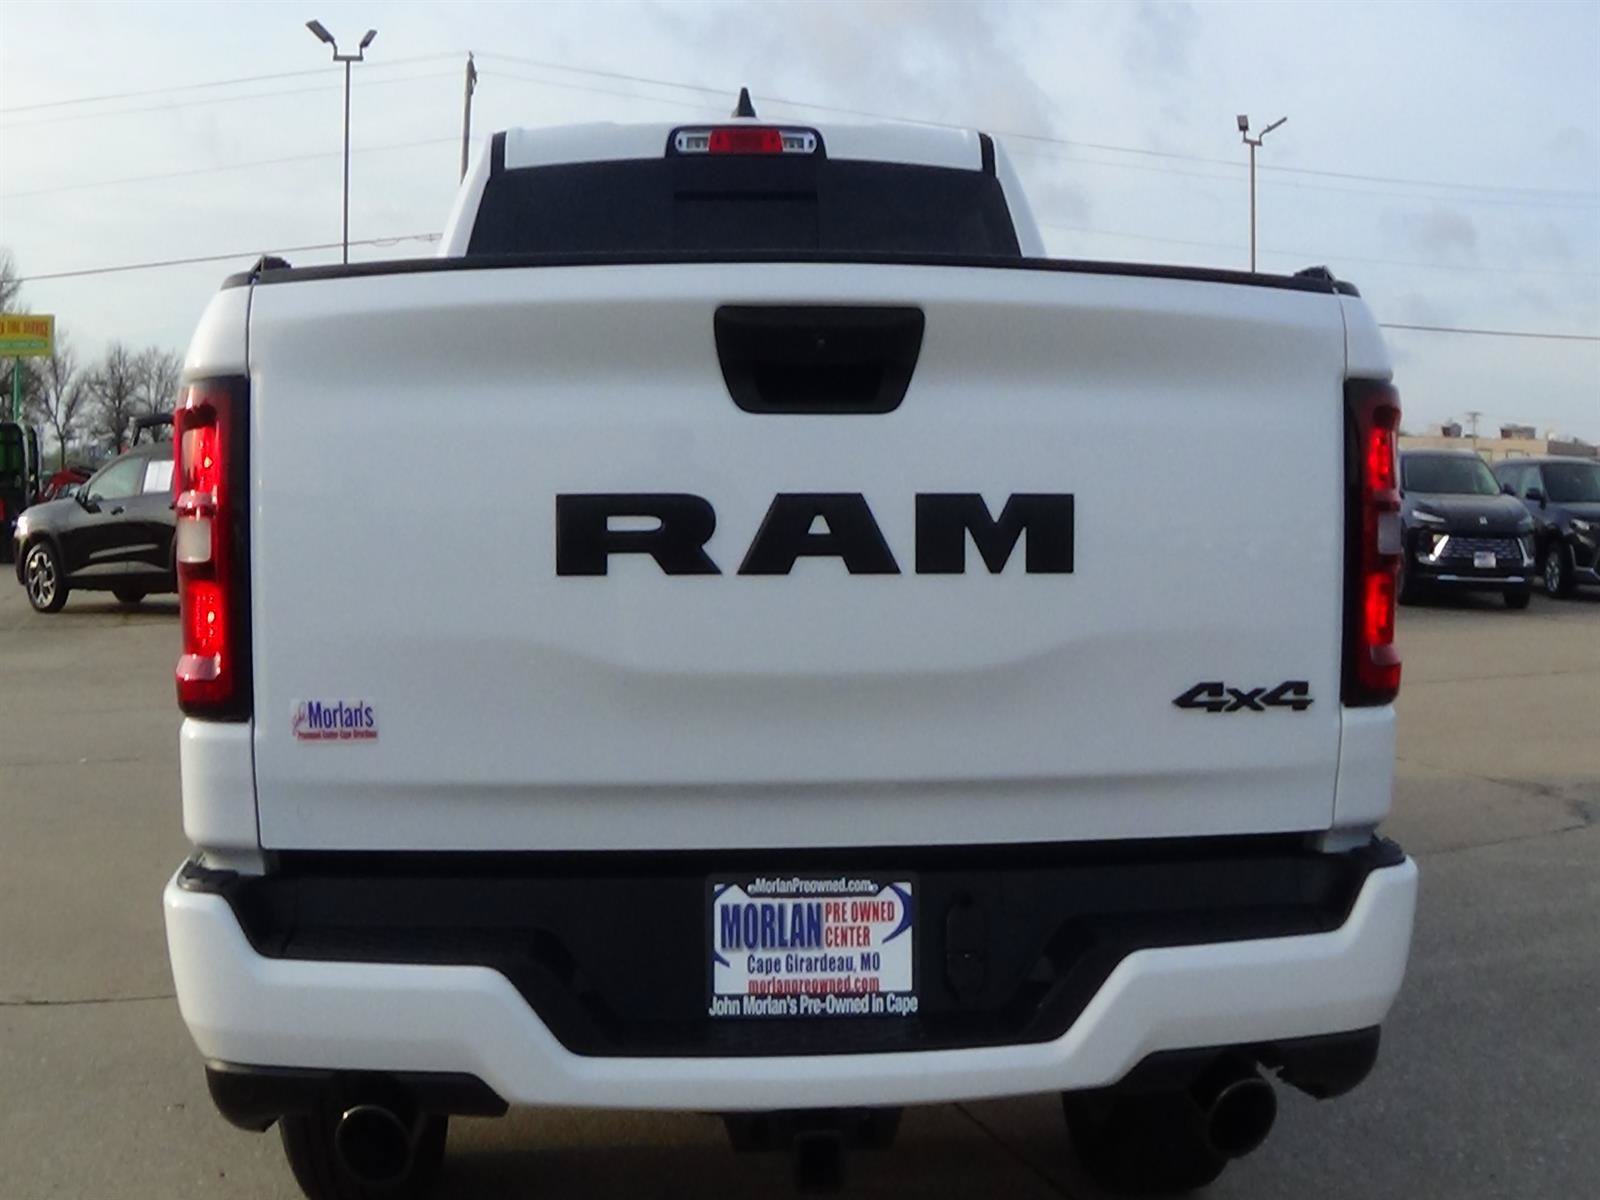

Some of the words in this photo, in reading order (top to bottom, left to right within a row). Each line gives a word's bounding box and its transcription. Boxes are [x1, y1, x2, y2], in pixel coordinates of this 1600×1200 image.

[556, 492, 1075, 576] RAM
[1172, 681, 1314, 712] 4x4
[308, 700, 374, 728] Morlan's
[825, 901, 847, 922] PRE
[851, 901, 895, 922] OWNED
[720, 902, 822, 949] MORLAN
[825, 926, 871, 948] CENTER
[747, 954, 781, 975] Cape
[785, 953, 856, 973] Girardeau,
[861, 952, 880, 972] MO
[709, 996, 740, 1015] John
[743, 996, 797, 1015] Morlan's
[800, 995, 869, 1014] Pre-Owned
[872, 994, 884, 1013] in
[886, 994, 918, 1016] Cape
